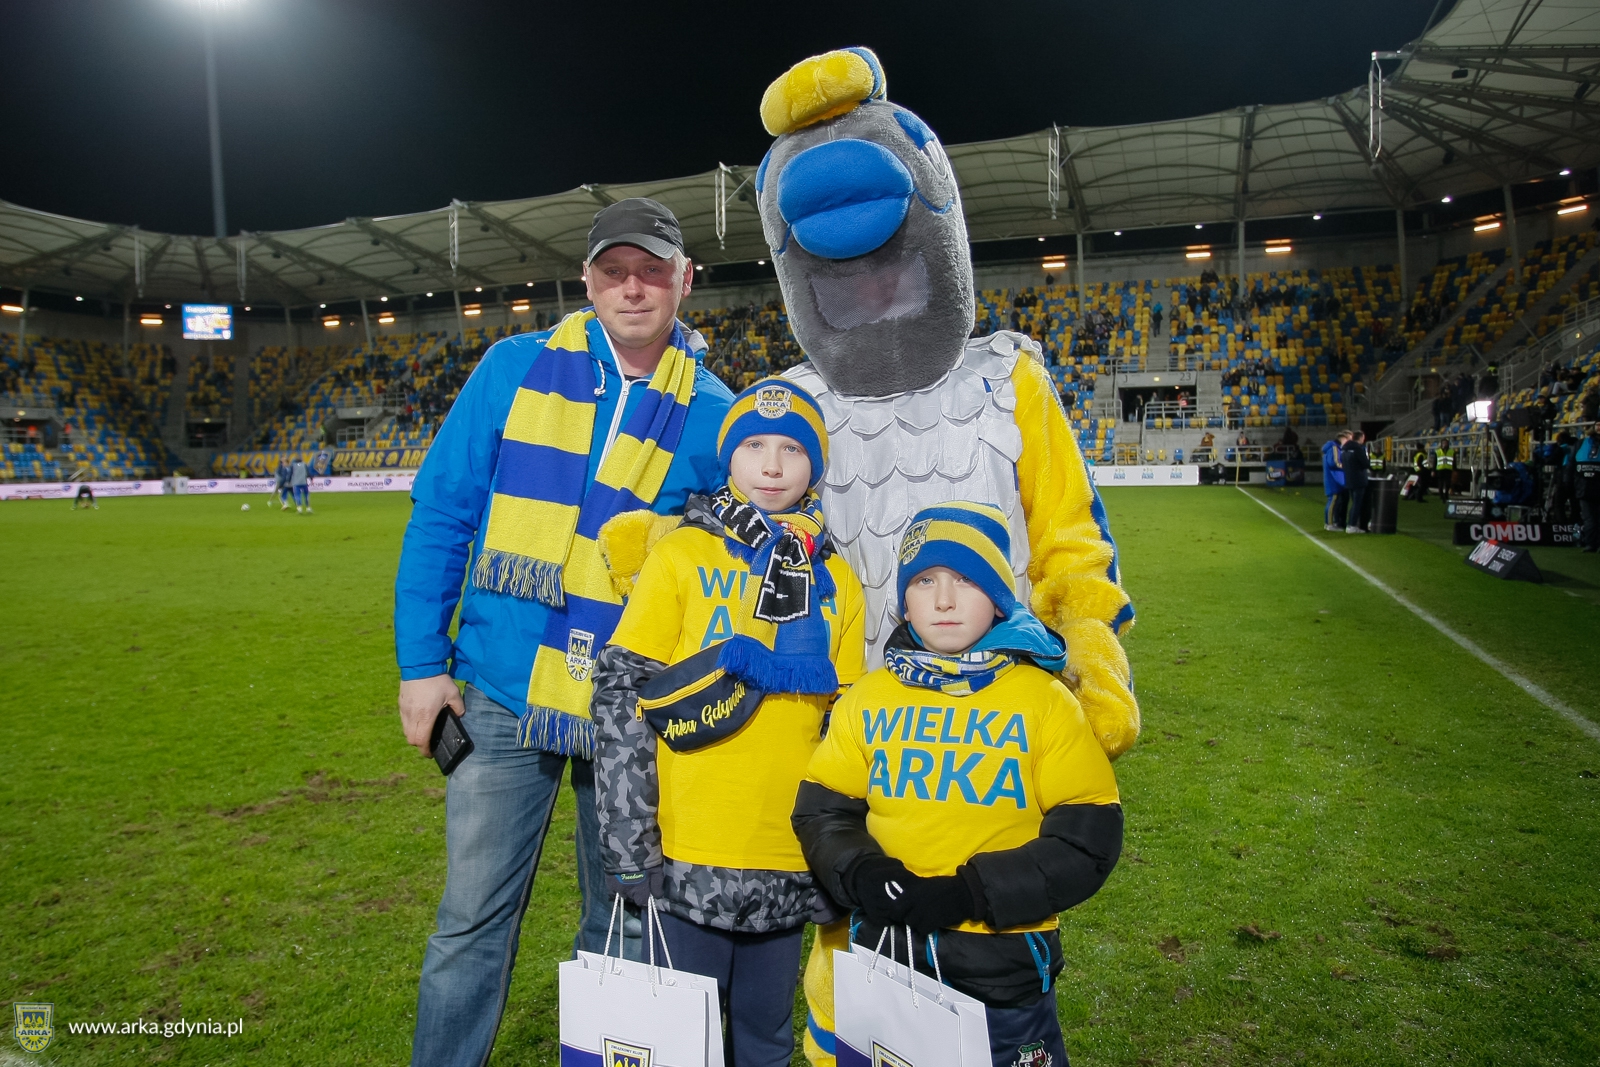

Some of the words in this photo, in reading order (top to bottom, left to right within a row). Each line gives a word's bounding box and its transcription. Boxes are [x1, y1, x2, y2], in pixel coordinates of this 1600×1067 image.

[1180, 373, 1192, 381] 23
[332, 451, 385, 468] ULTRAS
[1469, 523, 1541, 542] COMBU
[1553, 533, 1573, 542] DRI
[902, 539, 920, 555] ARKA
[570, 656, 587, 665] ARKA
[662, 718, 697, 741] Arka
[701, 681, 746, 728] Gdynia
[862, 705, 1029, 753] WIELKA
[868, 747, 1027, 809] ARKA
[1033, 1049, 1042, 1058] 19
